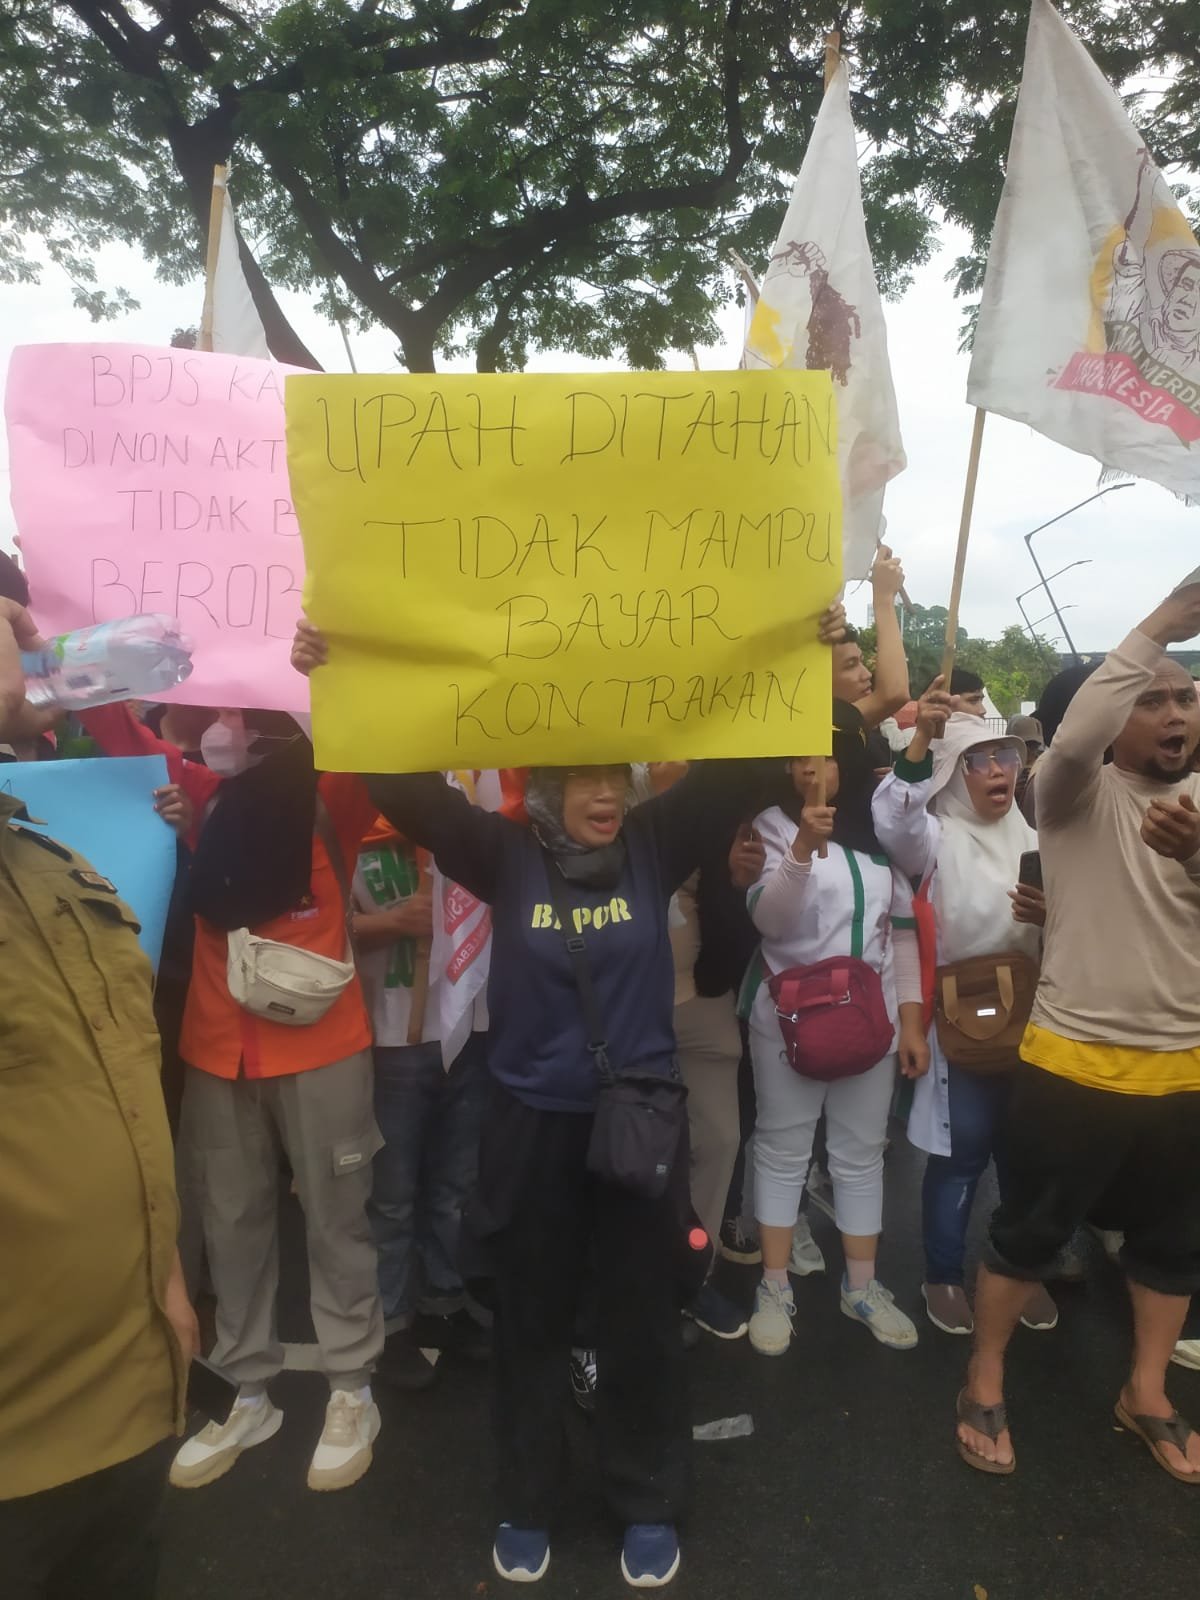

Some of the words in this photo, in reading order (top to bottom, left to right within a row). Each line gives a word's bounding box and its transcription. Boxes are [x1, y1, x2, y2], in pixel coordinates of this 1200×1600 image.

[91, 354, 201, 406] BPJS
[228, 364, 284, 406] KA
[1070, 357, 1176, 422] NESIA
[317, 391, 527, 483] UPAH
[560, 391, 836, 468] DITAHAN
[117, 489, 253, 533] TIDAK
[364, 513, 618, 579] TIDAK
[643, 507, 836, 571] MAMPU
[488, 584, 743, 663] BAYAR
